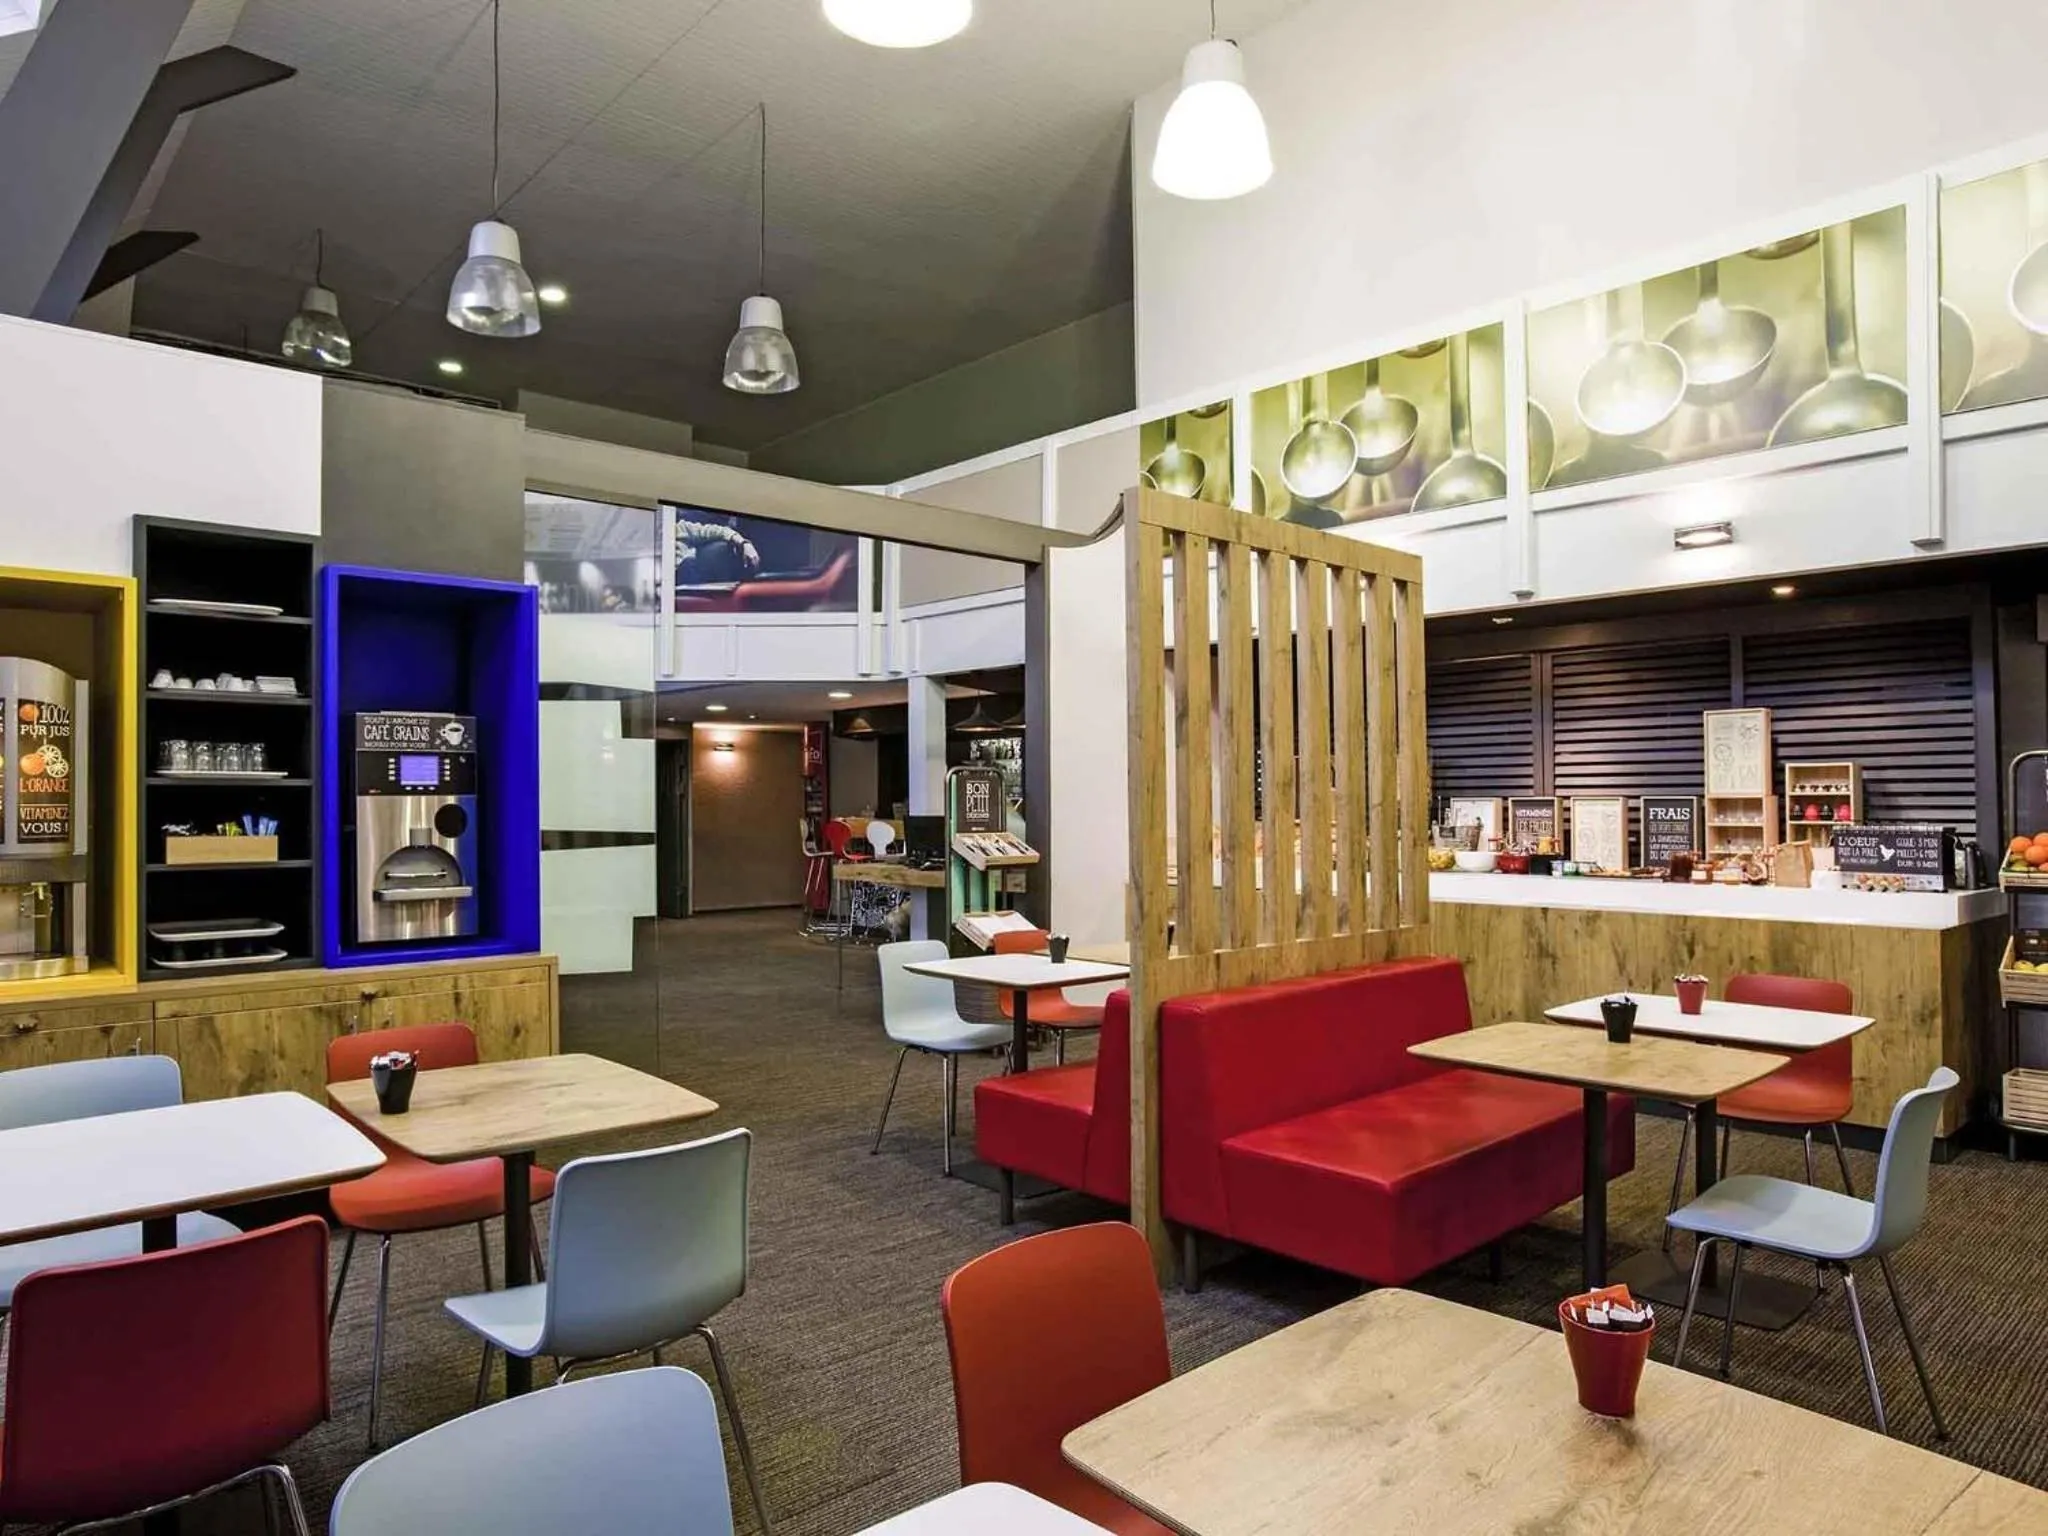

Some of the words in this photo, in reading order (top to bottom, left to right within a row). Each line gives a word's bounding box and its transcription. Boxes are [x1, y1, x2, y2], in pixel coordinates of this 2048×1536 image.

[40, 704, 69, 724] 100%
[20, 725, 47, 736] PUR
[49, 725, 70, 738] JUS
[393, 725, 430, 741] GRAINS
[20, 778, 69, 793] L'ORANGE
[966, 783, 990, 794] BON
[966, 794, 990, 812] PETIT
[20, 807, 69, 819] VITAMINEZ
[1649, 807, 1690, 820] FRAIS
[21, 822, 61, 834] VOUS
[1838, 836, 1879, 846] L'OEUF
[1923, 838, 1938, 848] MIN
[1924, 849, 1938, 858] MIN
[1923, 860, 1938, 868] MIN
